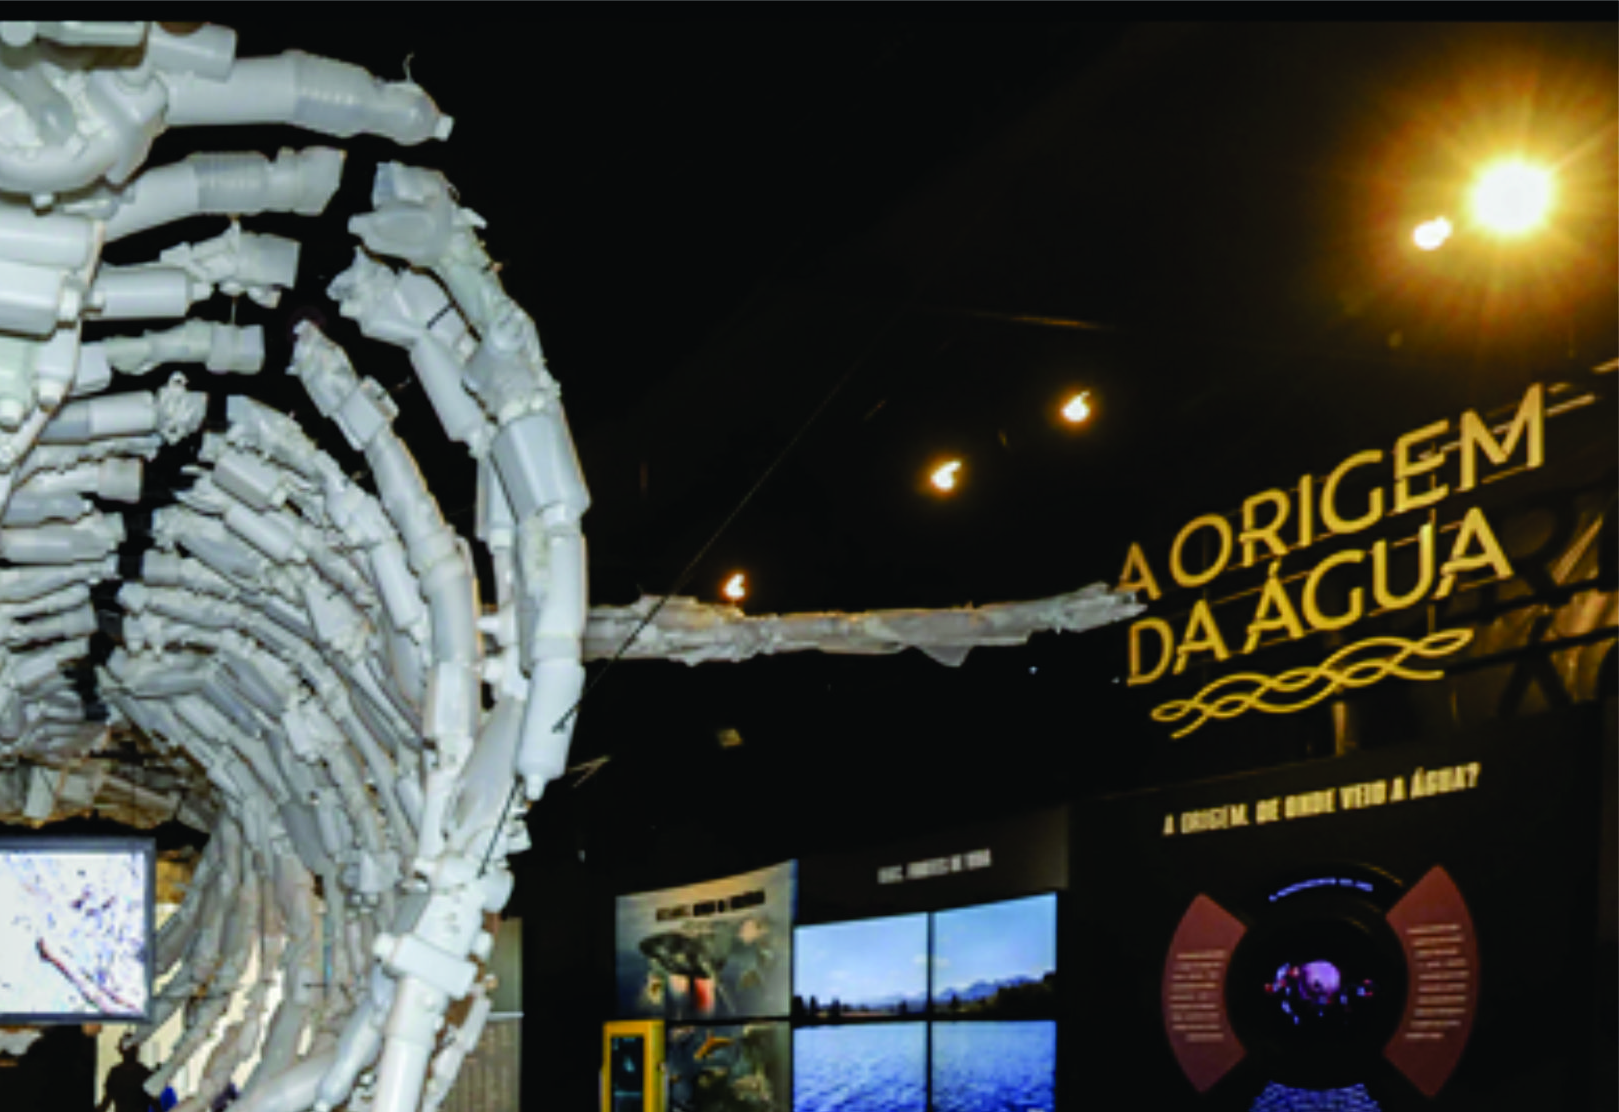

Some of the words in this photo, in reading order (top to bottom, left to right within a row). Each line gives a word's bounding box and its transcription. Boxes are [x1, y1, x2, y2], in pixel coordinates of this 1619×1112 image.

[1120, 542, 1161, 600] A
[1169, 382, 1544, 589] ORIGEM
[1127, 599, 1231, 687] DA
[1243, 507, 1514, 654] ÁGUA
[1389, 776, 1407, 803] A
